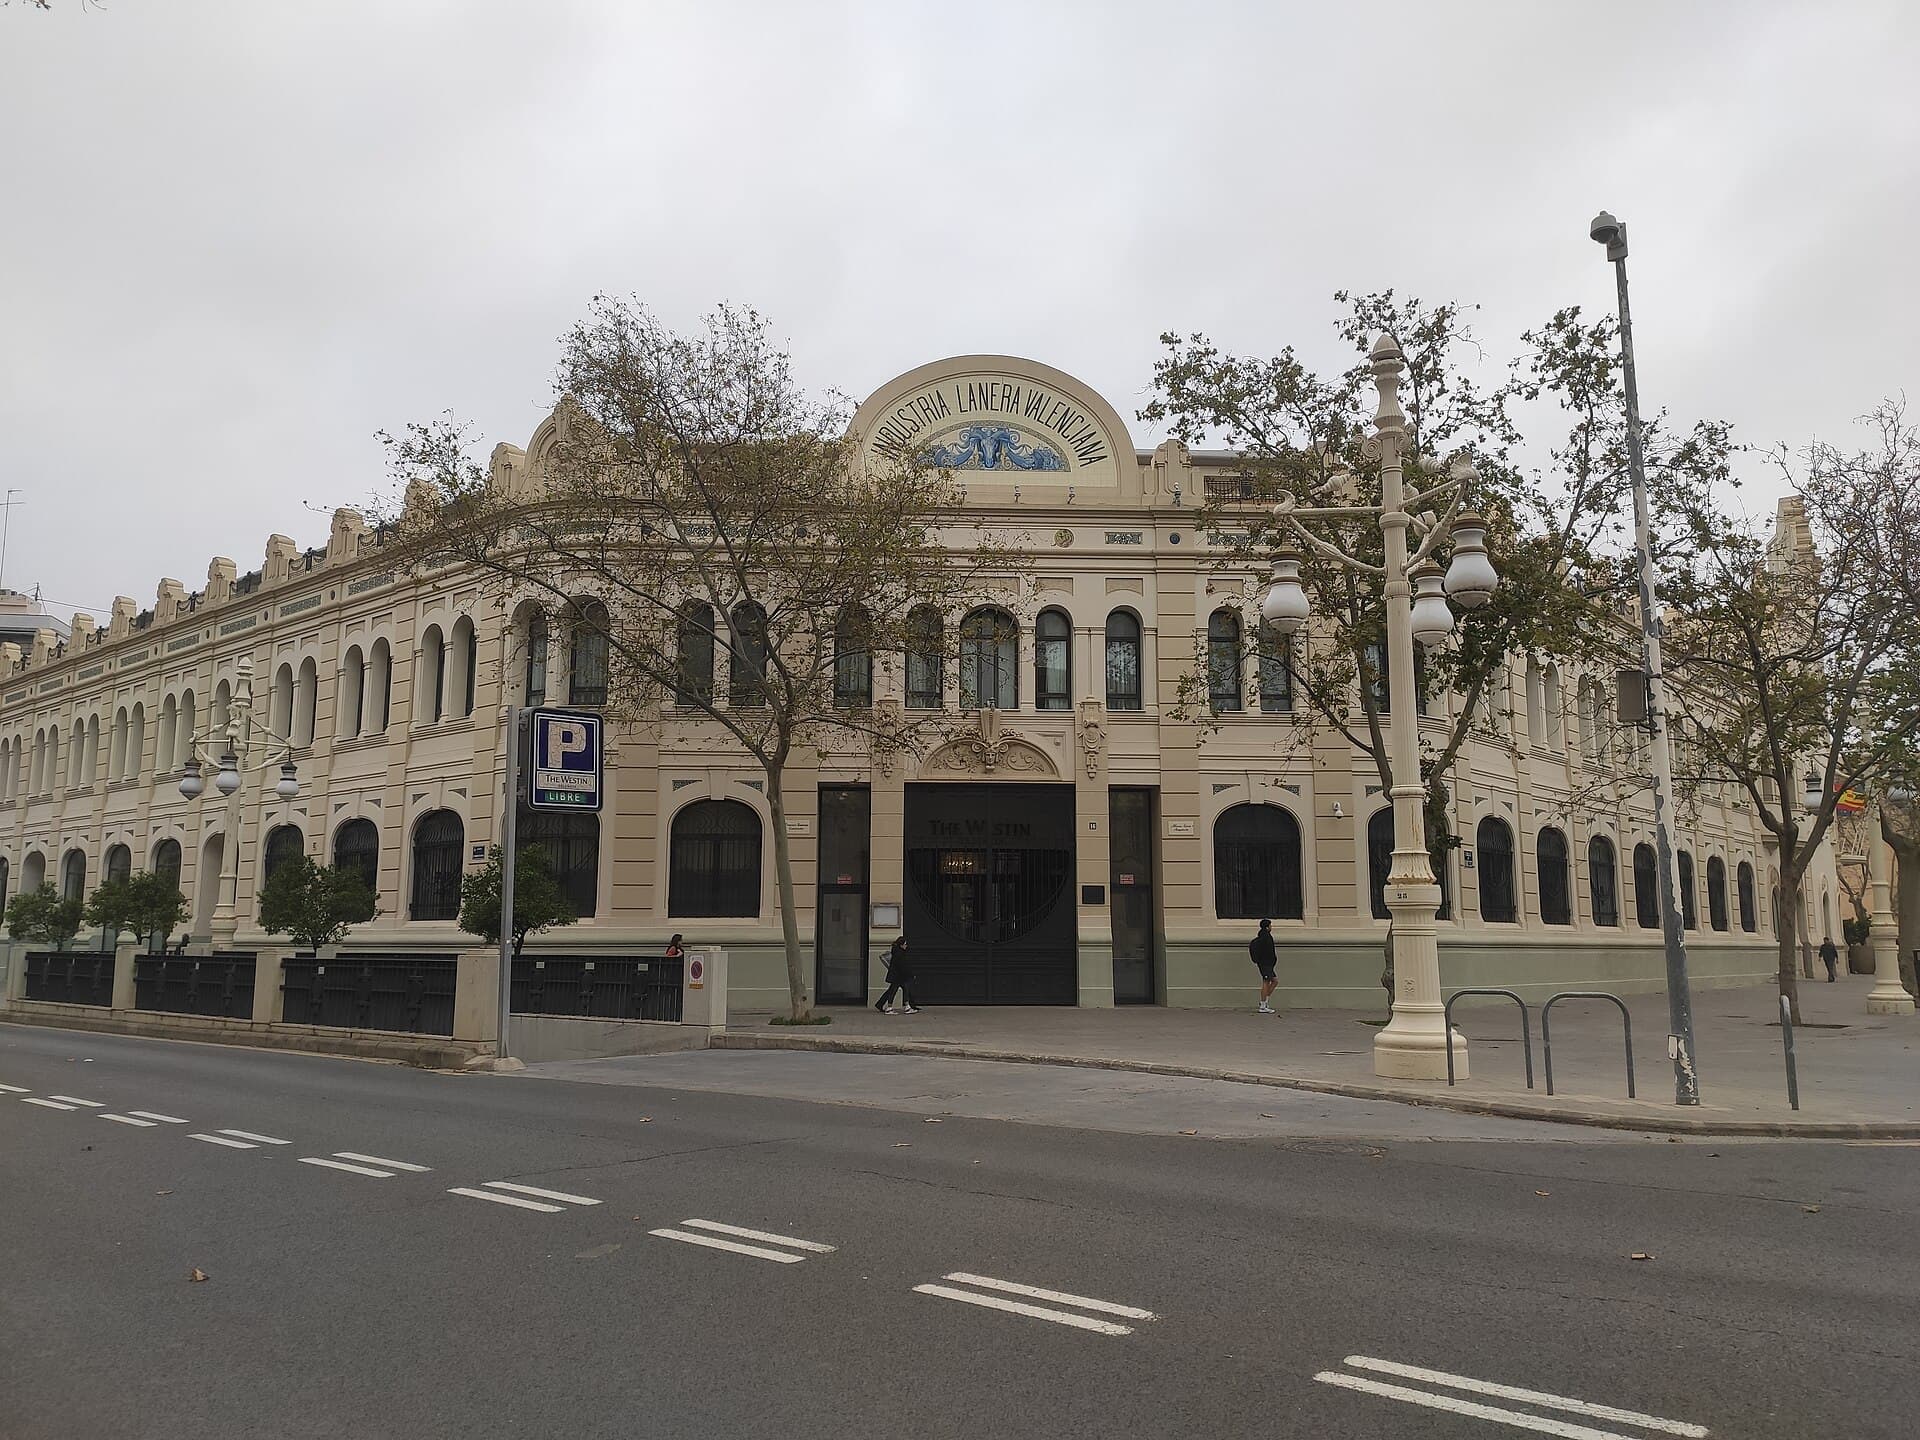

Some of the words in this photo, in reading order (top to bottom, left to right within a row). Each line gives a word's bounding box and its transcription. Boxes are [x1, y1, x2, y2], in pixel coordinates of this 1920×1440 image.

[870, 389, 952, 461] INDUSTRIA
[955, 382, 1021, 415] LANERA
[1024, 388, 1109, 468] VALENCIANA
[548, 720, 586, 768] P
[545, 774, 560, 783] THE
[560, 775, 588, 785] WESTIN
[549, 792, 581, 802] LIBRE
[928, 819, 961, 836] THE
[965, 819, 1031, 837] WSTIN
